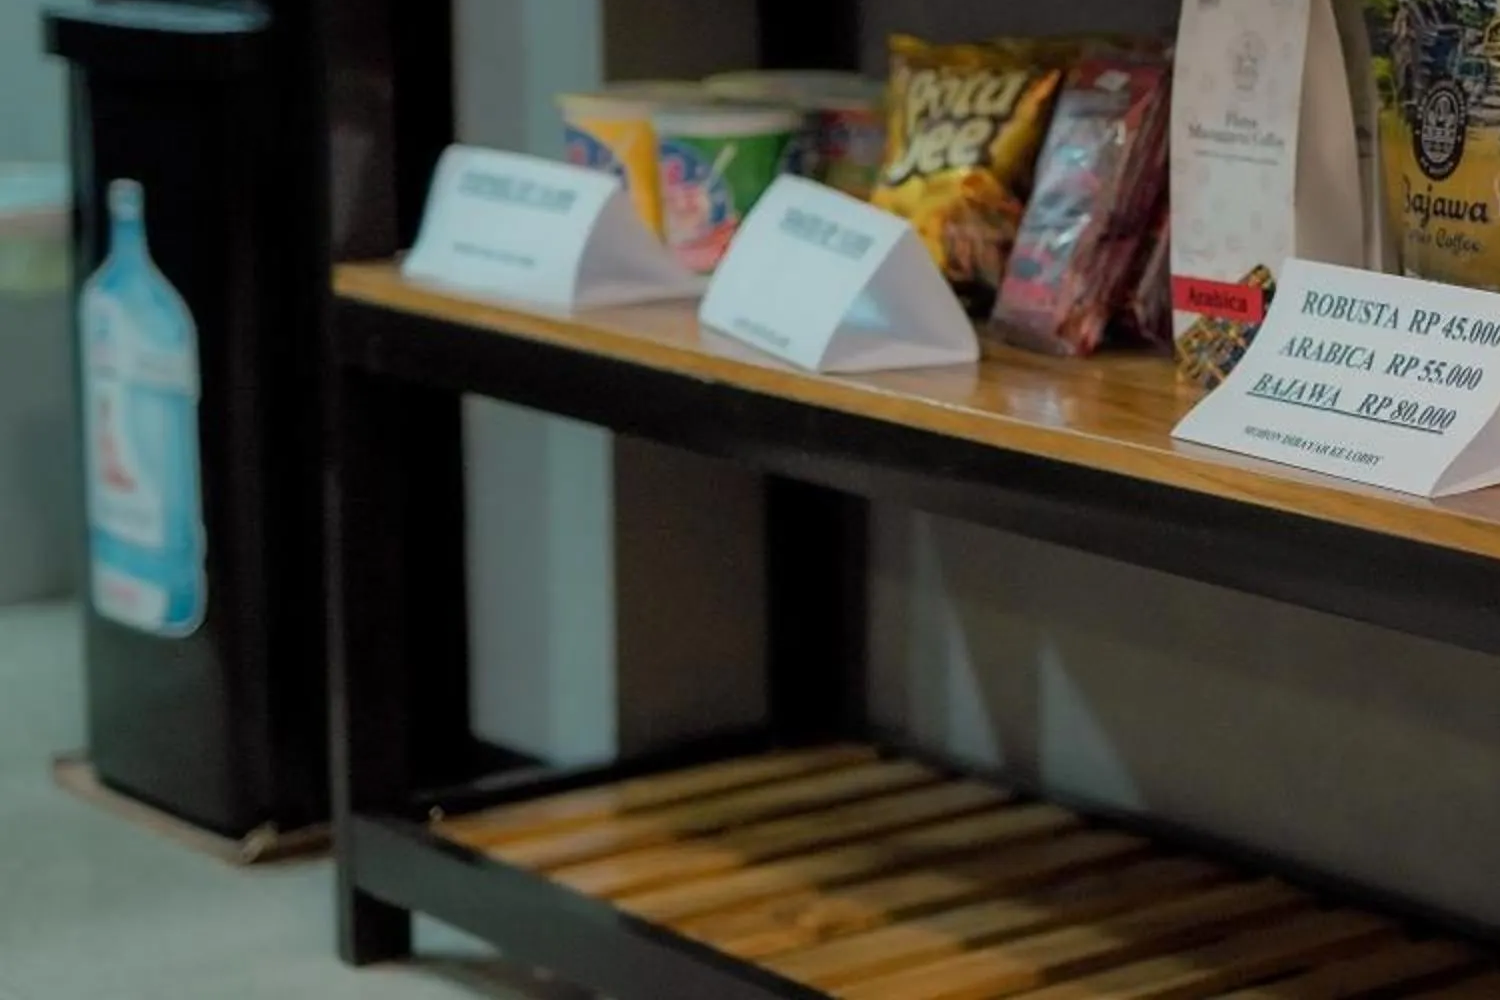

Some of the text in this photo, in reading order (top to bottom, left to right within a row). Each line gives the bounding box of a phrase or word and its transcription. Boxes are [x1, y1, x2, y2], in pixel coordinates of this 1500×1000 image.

[1301, 290, 1399, 330] ROBUSTA
[1408, 309, 1441, 335] RP
[1278, 335, 1483, 390] ARABICA RP 55.000
[1252, 373, 1457, 429] BAJAWA RP 80.000
[1345, 449, 1384, 466] LOBBY
